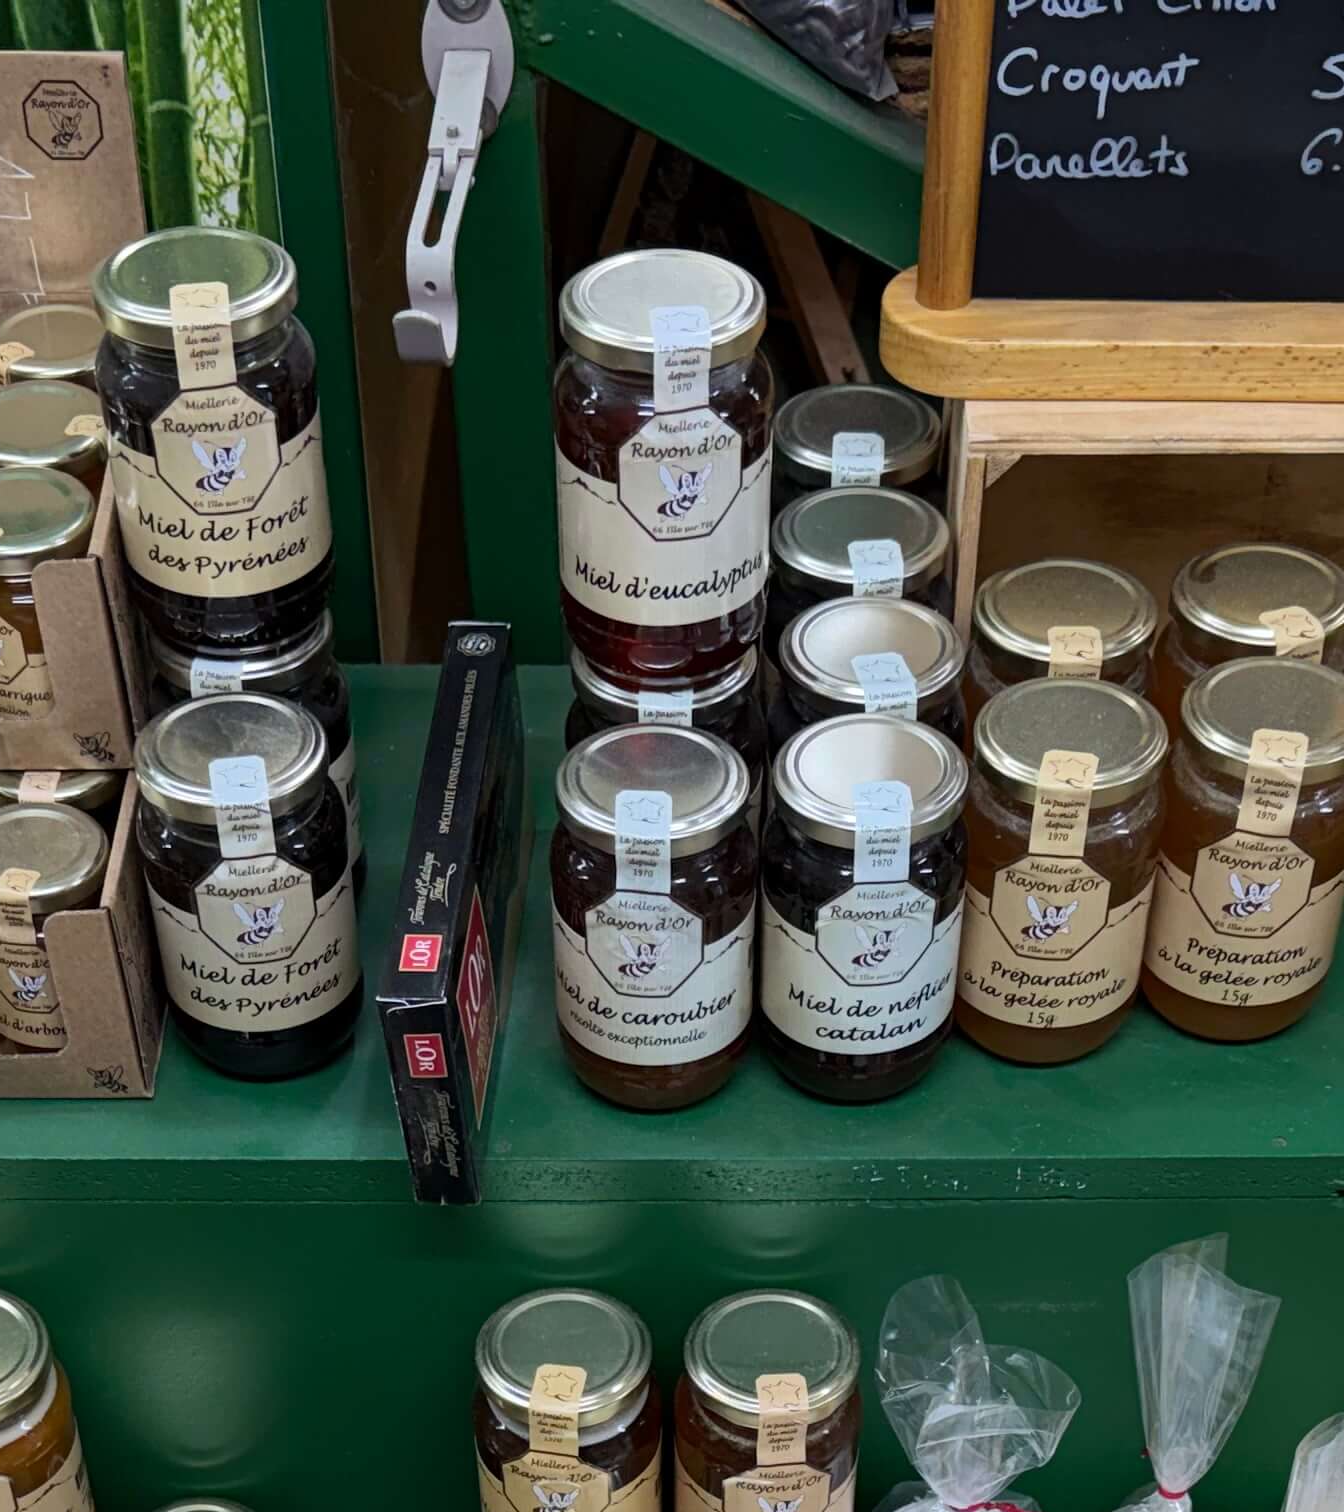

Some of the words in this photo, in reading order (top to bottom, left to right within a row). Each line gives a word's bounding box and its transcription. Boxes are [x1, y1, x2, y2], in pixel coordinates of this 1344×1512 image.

[996, 47, 1200, 120] Croquant
[162, 417, 226, 438] Rayon
[227, 409, 268, 430] d'Or
[631, 438, 694, 462] Rayon
[695, 431, 738, 456] d'Or
[138, 505, 195, 541] Miel
[199, 516, 239, 542] de
[246, 494, 310, 540] Forêt
[147, 543, 191, 573] des
[195, 534, 312, 580] Pyrénées
[575, 552, 622, 595] Miel
[624, 550, 767, 601] d'eucalyptus
[1268, 855, 1310, 872] d'Or
[205, 884, 267, 903] Rayon
[1064, 877, 1105, 894] d'Or
[594, 909, 655, 932] Rayon
[179, 953, 237, 987] Miel
[242, 964, 278, 987] de
[283, 937, 344, 982] Forêt
[1187, 937, 1307, 965] Préparation
[990, 959, 1110, 990] Préparation
[1173, 952, 1194, 975] la
[1198, 963, 1260, 988] gelée
[1262, 955, 1322, 986] royale
[189, 985, 231, 1012] des
[234, 972, 344, 1018] Pyrénées
[788, 983, 844, 1016] Miel
[845, 996, 883, 1017] de
[887, 967, 954, 1015] néflier
[963, 970, 977, 985] à
[978, 974, 1002, 999] la
[1003, 985, 1064, 1009] gelée
[1065, 976, 1128, 1008] royale
[1221, 987, 1252, 1006] 15g
[586, 998, 618, 1022] de
[621, 987, 739, 1026] caroubier
[1026, 1010, 1057, 1029] 15g
[607, 1028, 708, 1049] exceptionnelle
[815, 1015, 928, 1043] catalan
